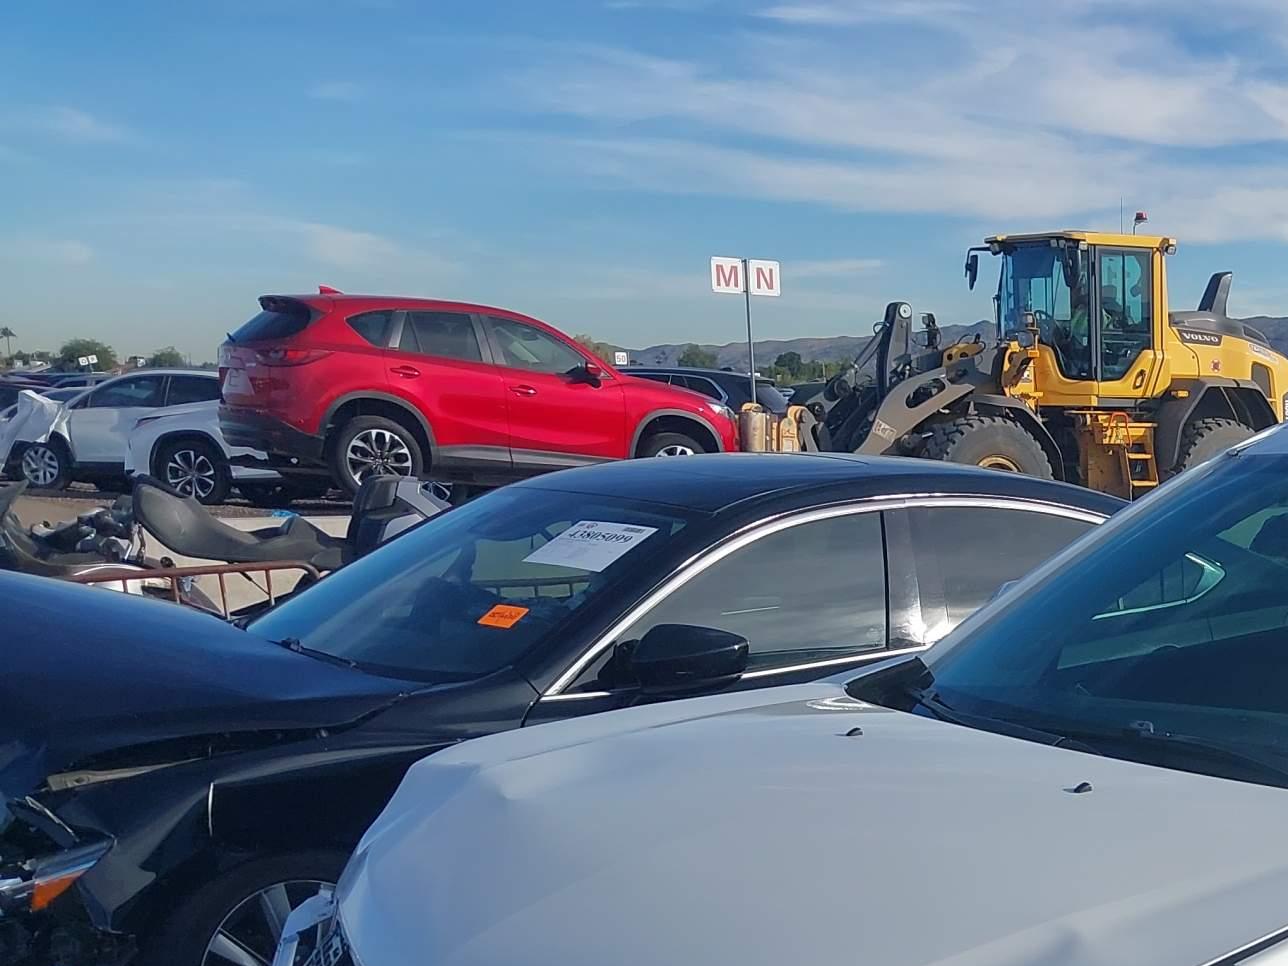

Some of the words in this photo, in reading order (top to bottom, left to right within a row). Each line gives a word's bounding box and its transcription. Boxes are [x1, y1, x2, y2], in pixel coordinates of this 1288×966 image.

[715, 263, 738, 288] M
[756, 267, 774, 290] N
[1182, 332, 1218, 343] VOLVO
[568, 529, 633, 544] 43805099
